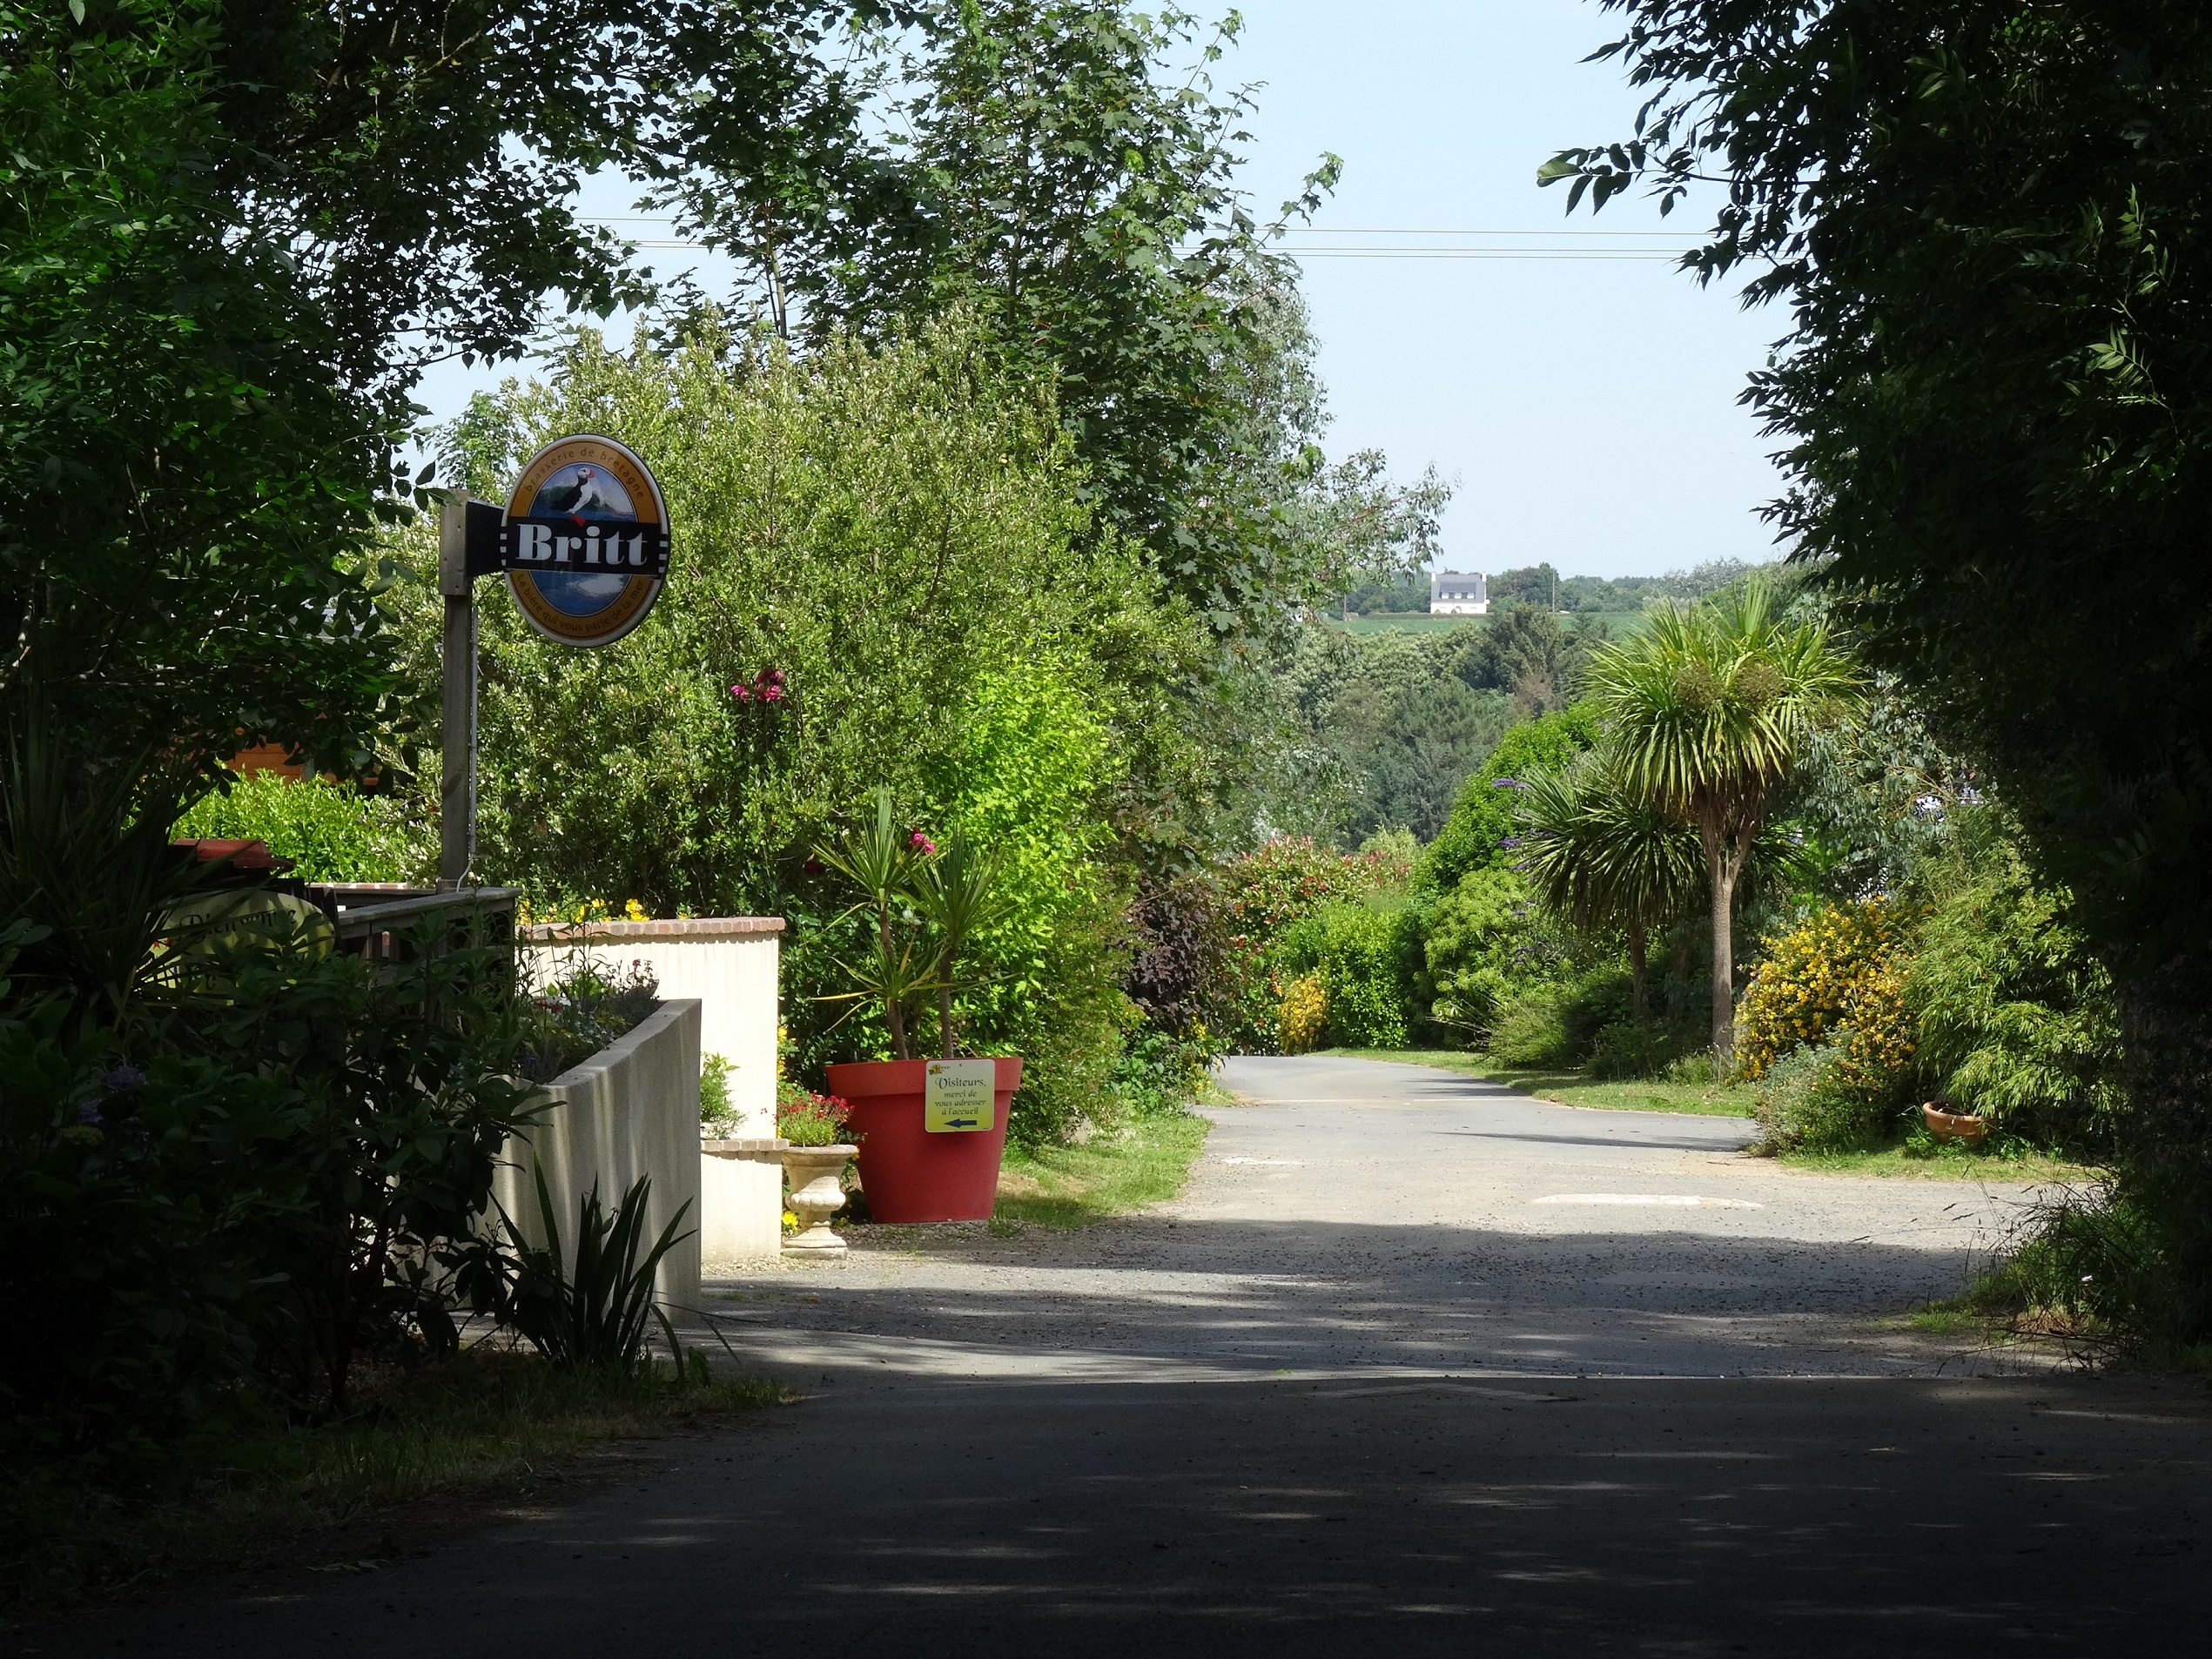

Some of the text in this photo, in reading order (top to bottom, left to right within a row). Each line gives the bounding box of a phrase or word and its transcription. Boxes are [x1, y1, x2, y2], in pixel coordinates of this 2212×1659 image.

[524, 447, 644, 498] brasserie de bretagne
[515, 523, 648, 567] Britt
[517, 574, 645, 633] La bière qui vous parle de la mer
[934, 1077, 986, 1090] Visiteurs,
[954, 1098, 986, 1106] adresser
